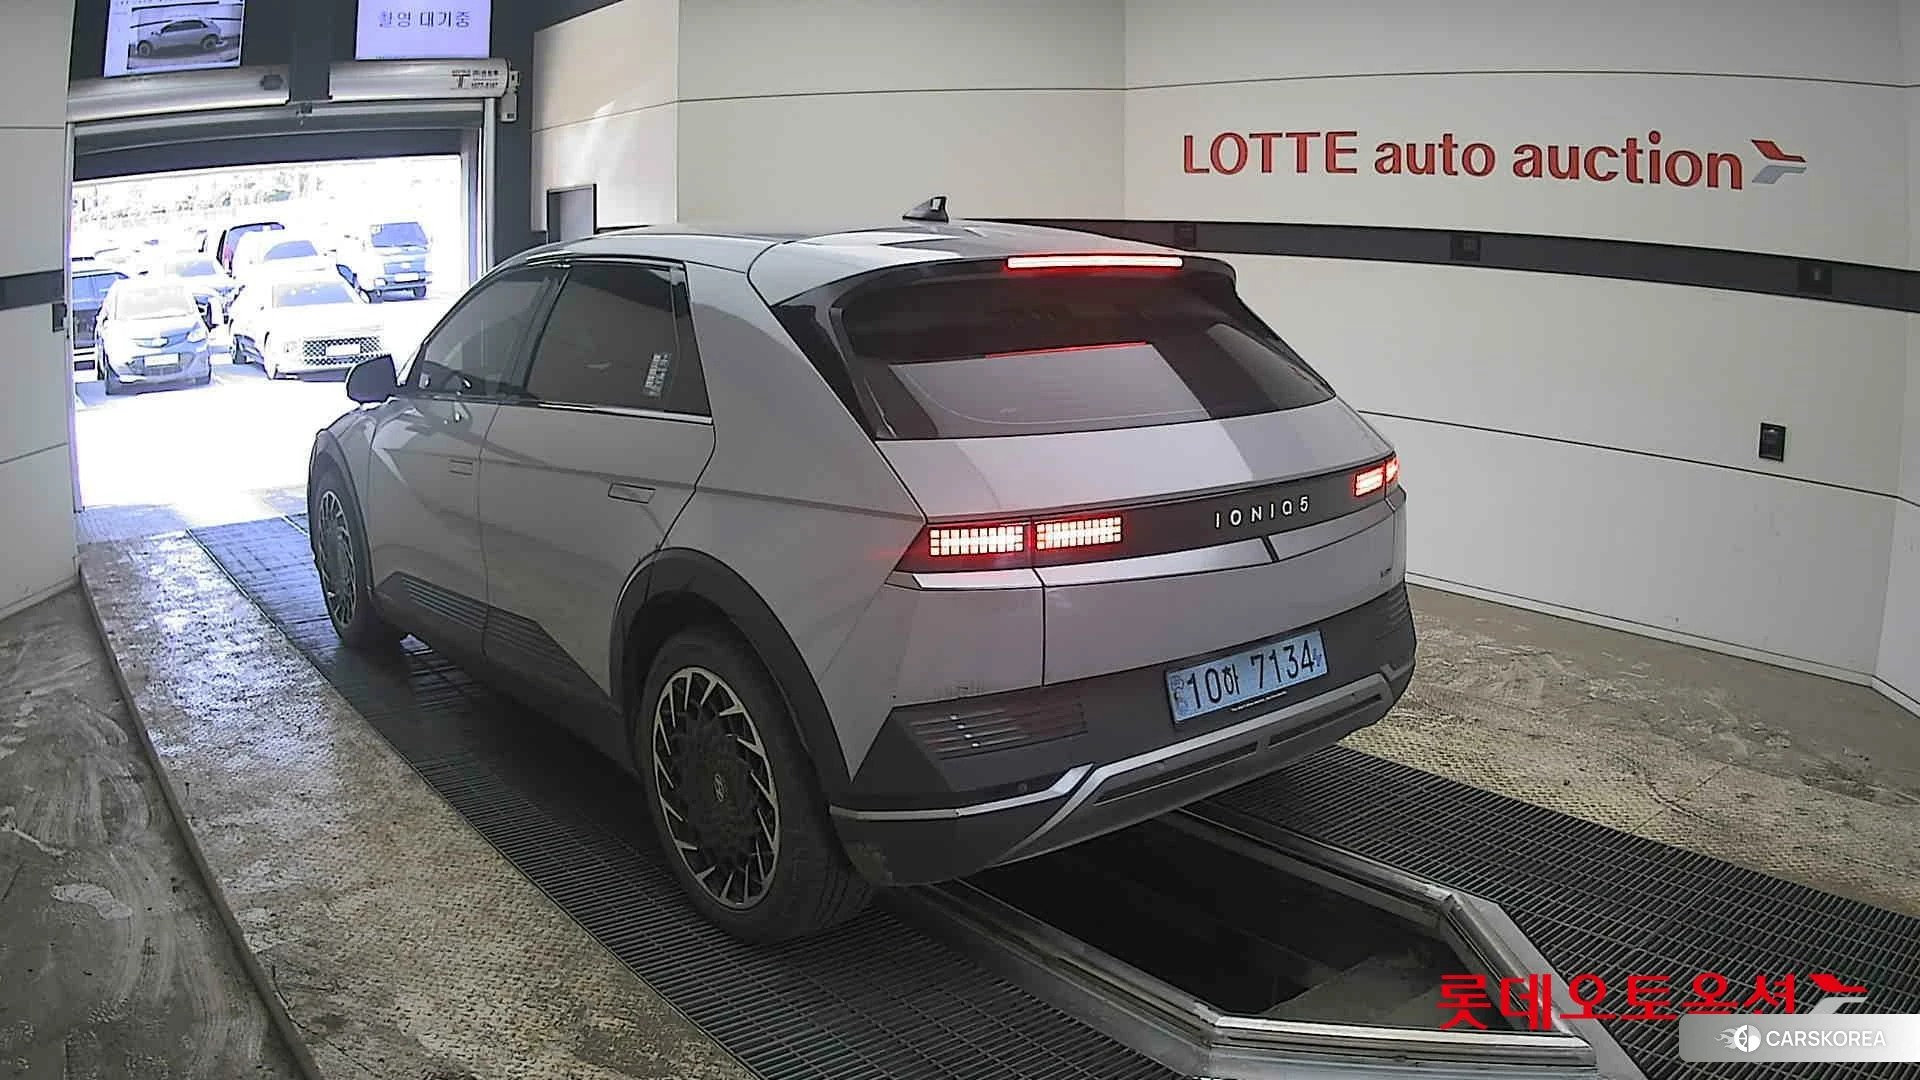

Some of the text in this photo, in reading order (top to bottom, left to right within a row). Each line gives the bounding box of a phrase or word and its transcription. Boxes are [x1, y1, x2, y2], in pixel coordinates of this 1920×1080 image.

[420, 11, 471, 28] 대기중
[1183, 130, 1744, 190] LOTTE auto auction
[1251, 639, 1314, 689] 7134
